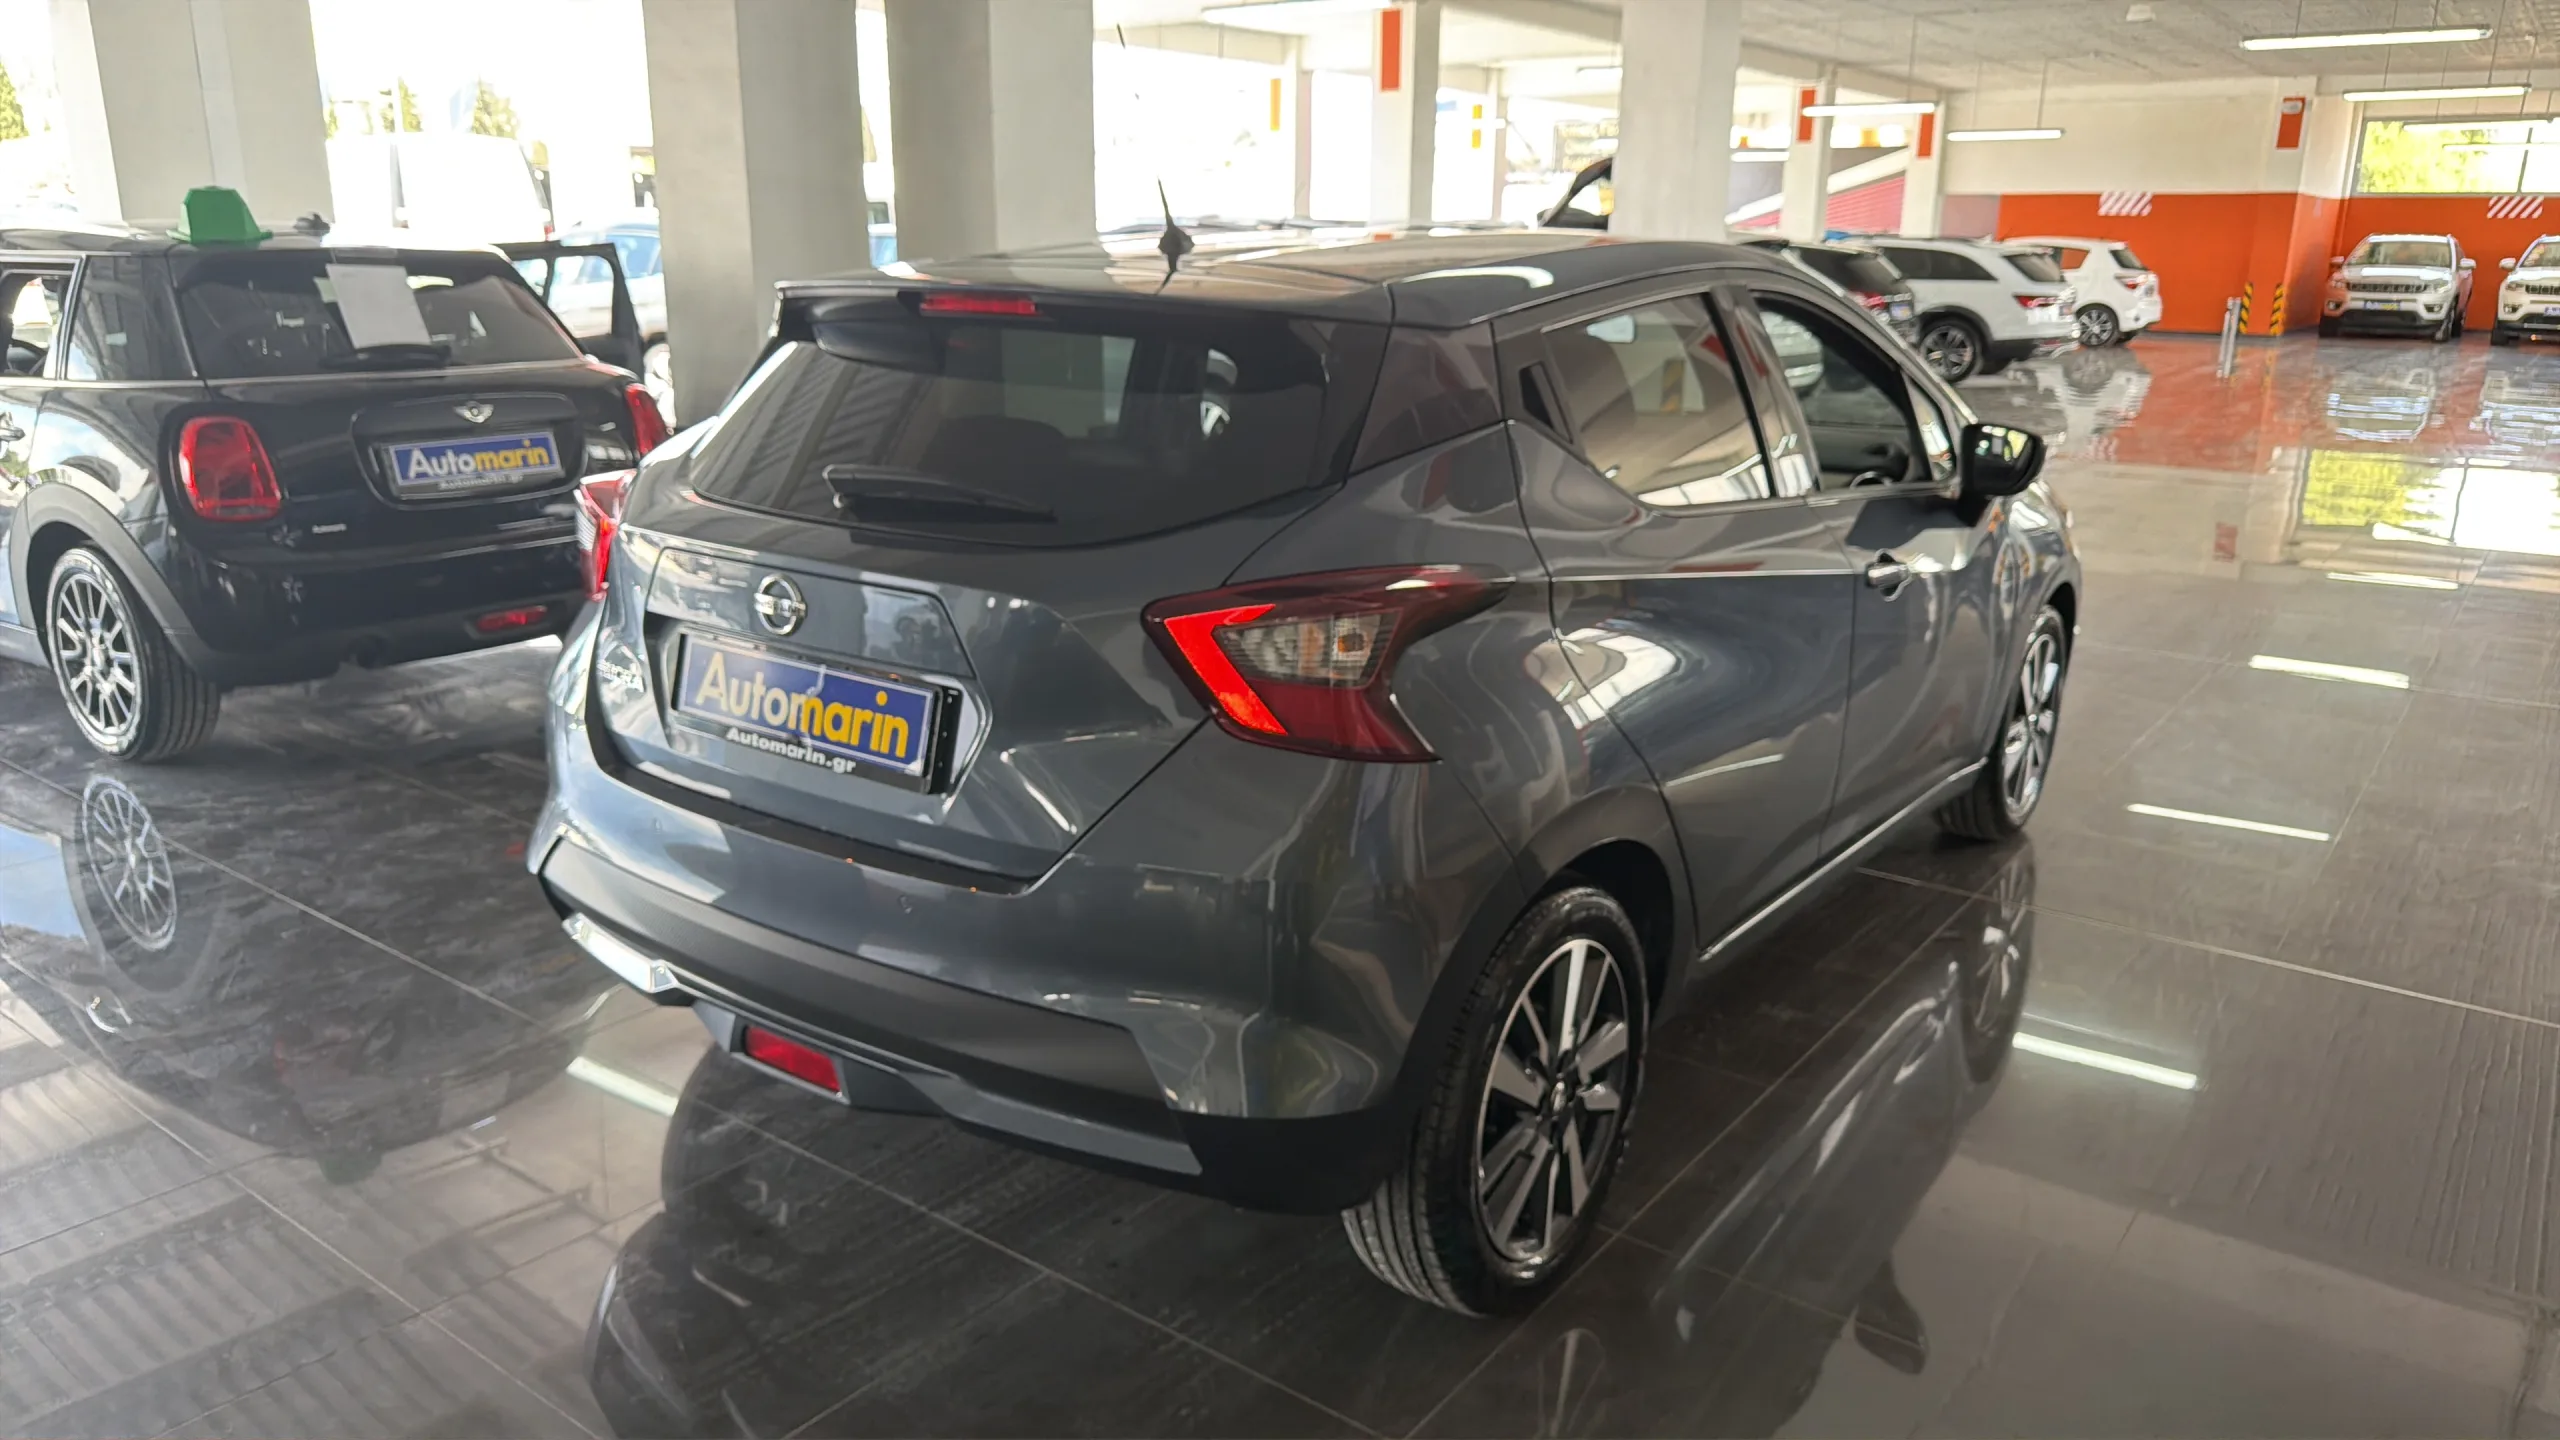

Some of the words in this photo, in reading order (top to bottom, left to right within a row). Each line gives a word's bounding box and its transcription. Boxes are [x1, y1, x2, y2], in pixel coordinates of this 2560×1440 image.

[408, 439, 549, 479] Automarin
[696, 651, 910, 758] Automarin
[726, 727, 856, 774] Automarin.gr
